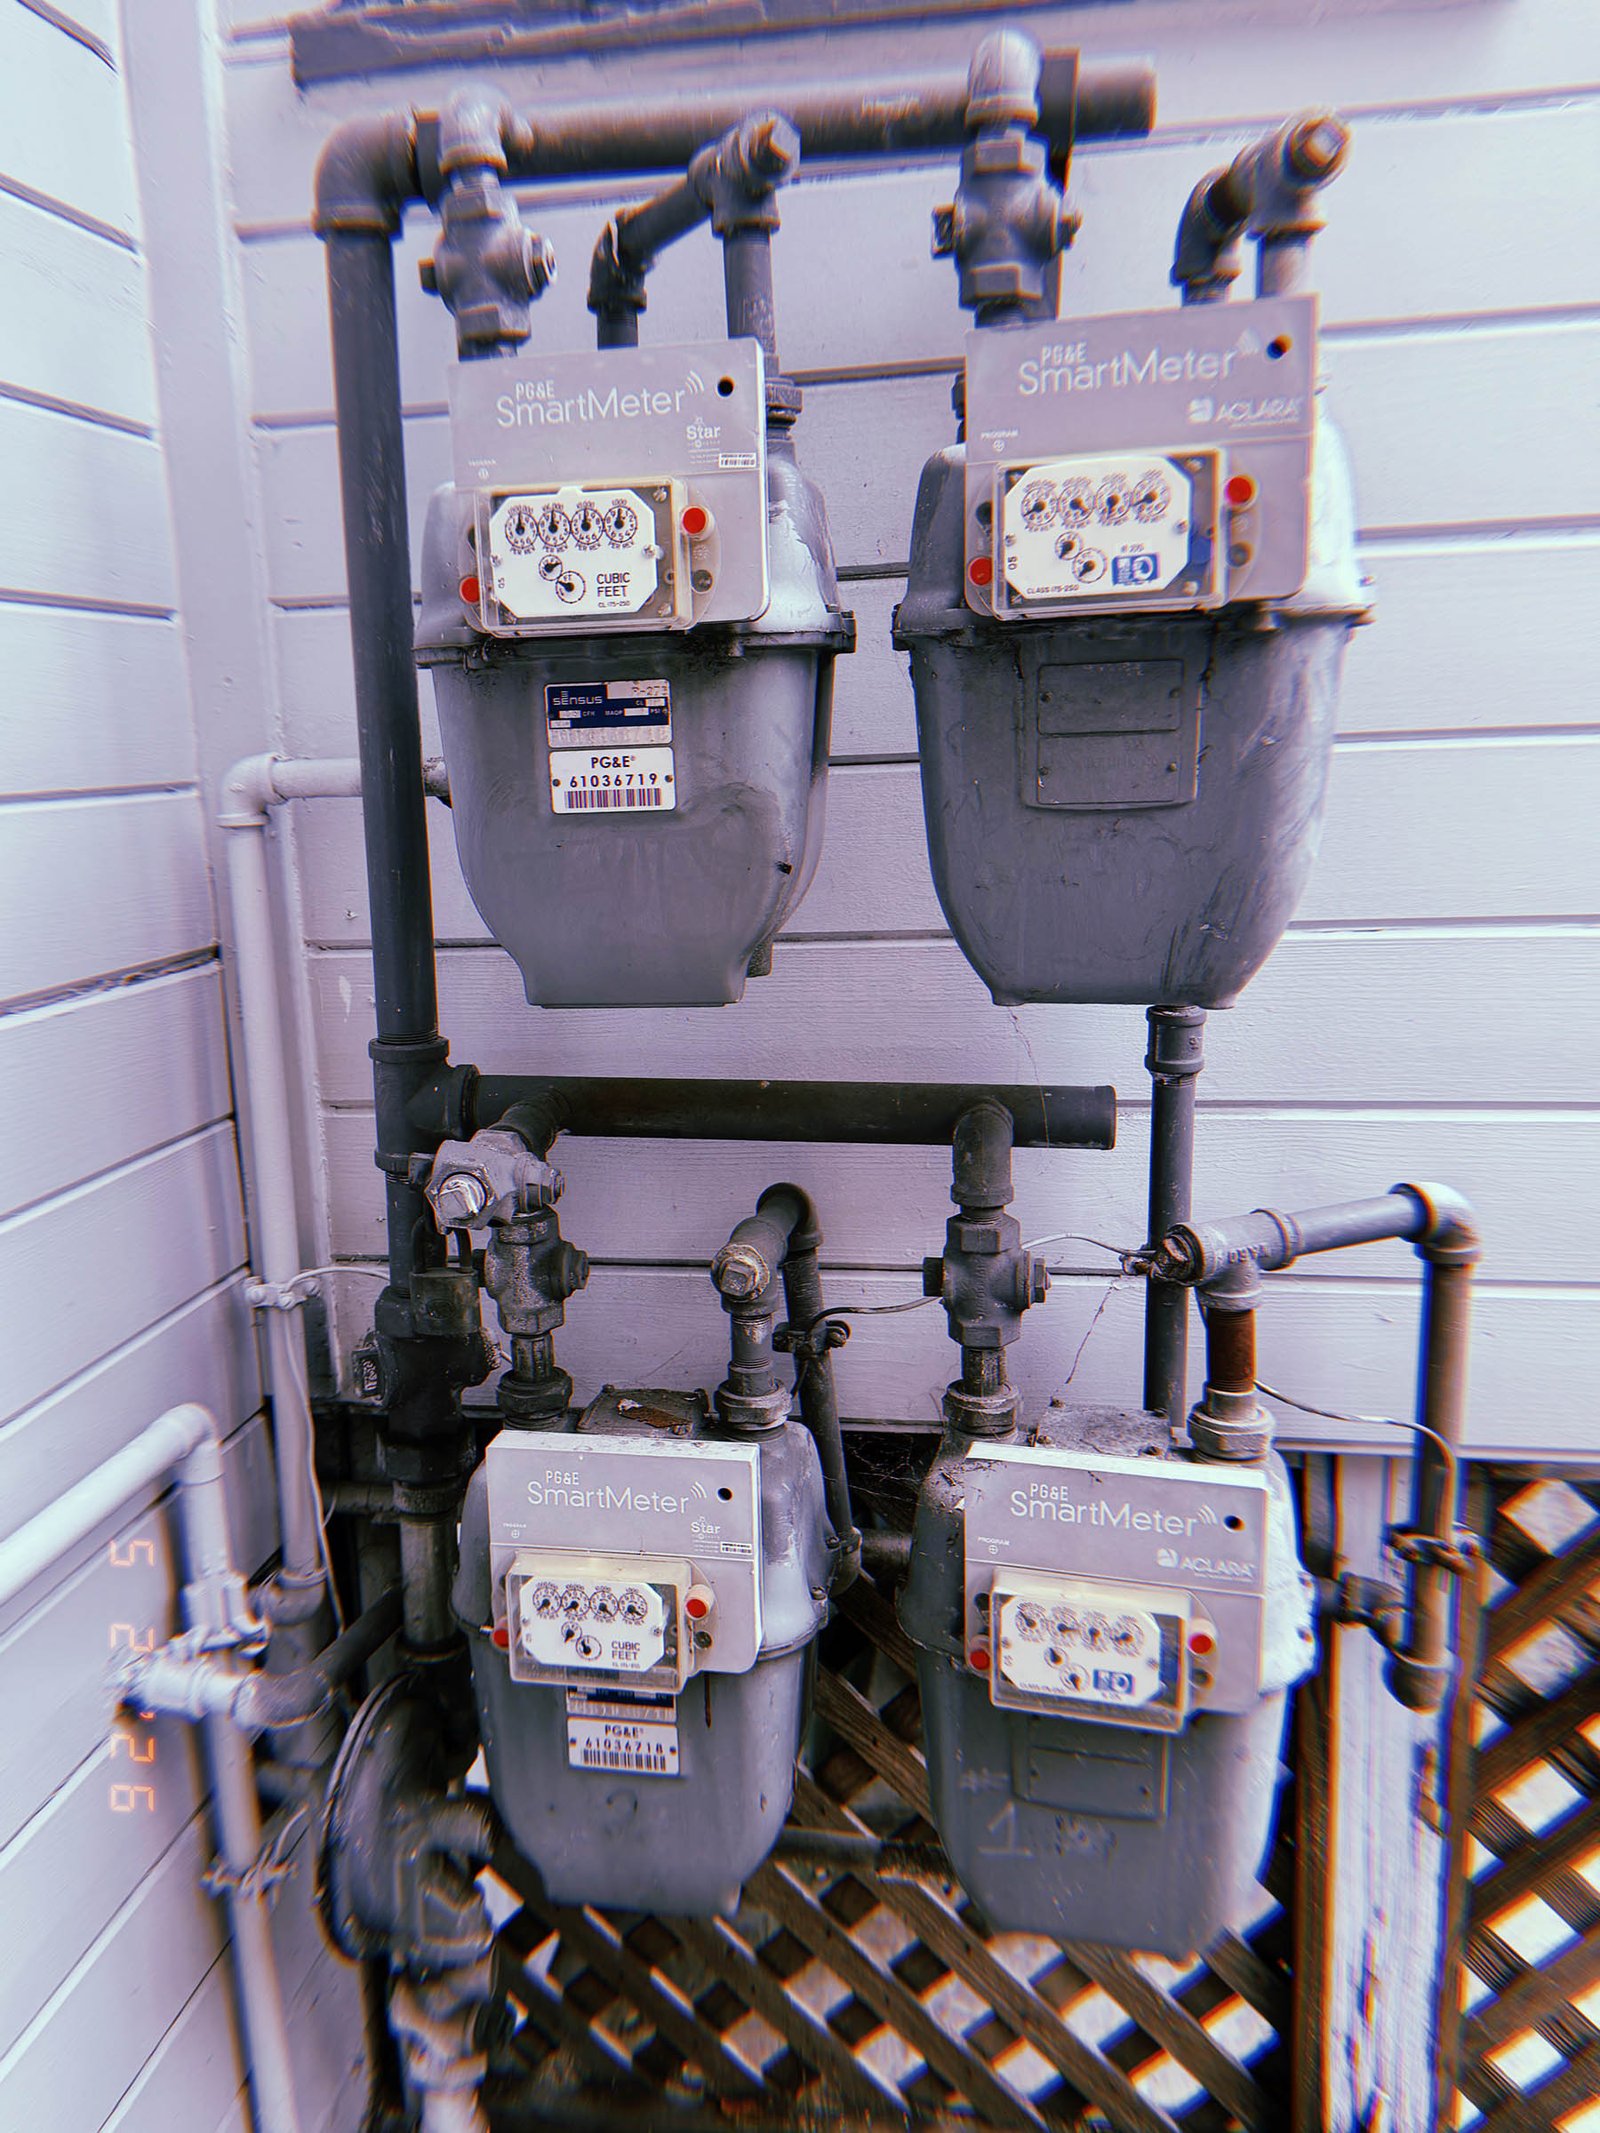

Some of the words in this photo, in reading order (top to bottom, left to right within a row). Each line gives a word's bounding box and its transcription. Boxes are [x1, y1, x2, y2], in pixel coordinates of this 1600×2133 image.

[1041, 342, 1086, 366] PG&E
[1019, 347, 1235, 395] SmartMeter
[516, 380, 555, 400] PG&E
[496, 387, 685, 428] SmartMeter
[1217, 398, 1297, 421] ACLARA
[687, 424, 720, 439] Star
[596, 572, 631, 584] CUBIC
[597, 585, 628, 597] FEET
[570, 773, 658, 788] 61036719
[545, 1471, 580, 1486] PG&E
[527, 1481, 689, 1514] SmartMeter
[1029, 1482, 1068, 1501] PG&E
[1010, 1489, 1200, 1537] SmartMeter
[690, 1521, 720, 1534] Star
[1182, 1556, 1254, 1579] ACLARA
[611, 1640, 640, 1652] CUBIC
[611, 1650, 638, 1660] FEET
[977, 1800, 1034, 1858] 1
